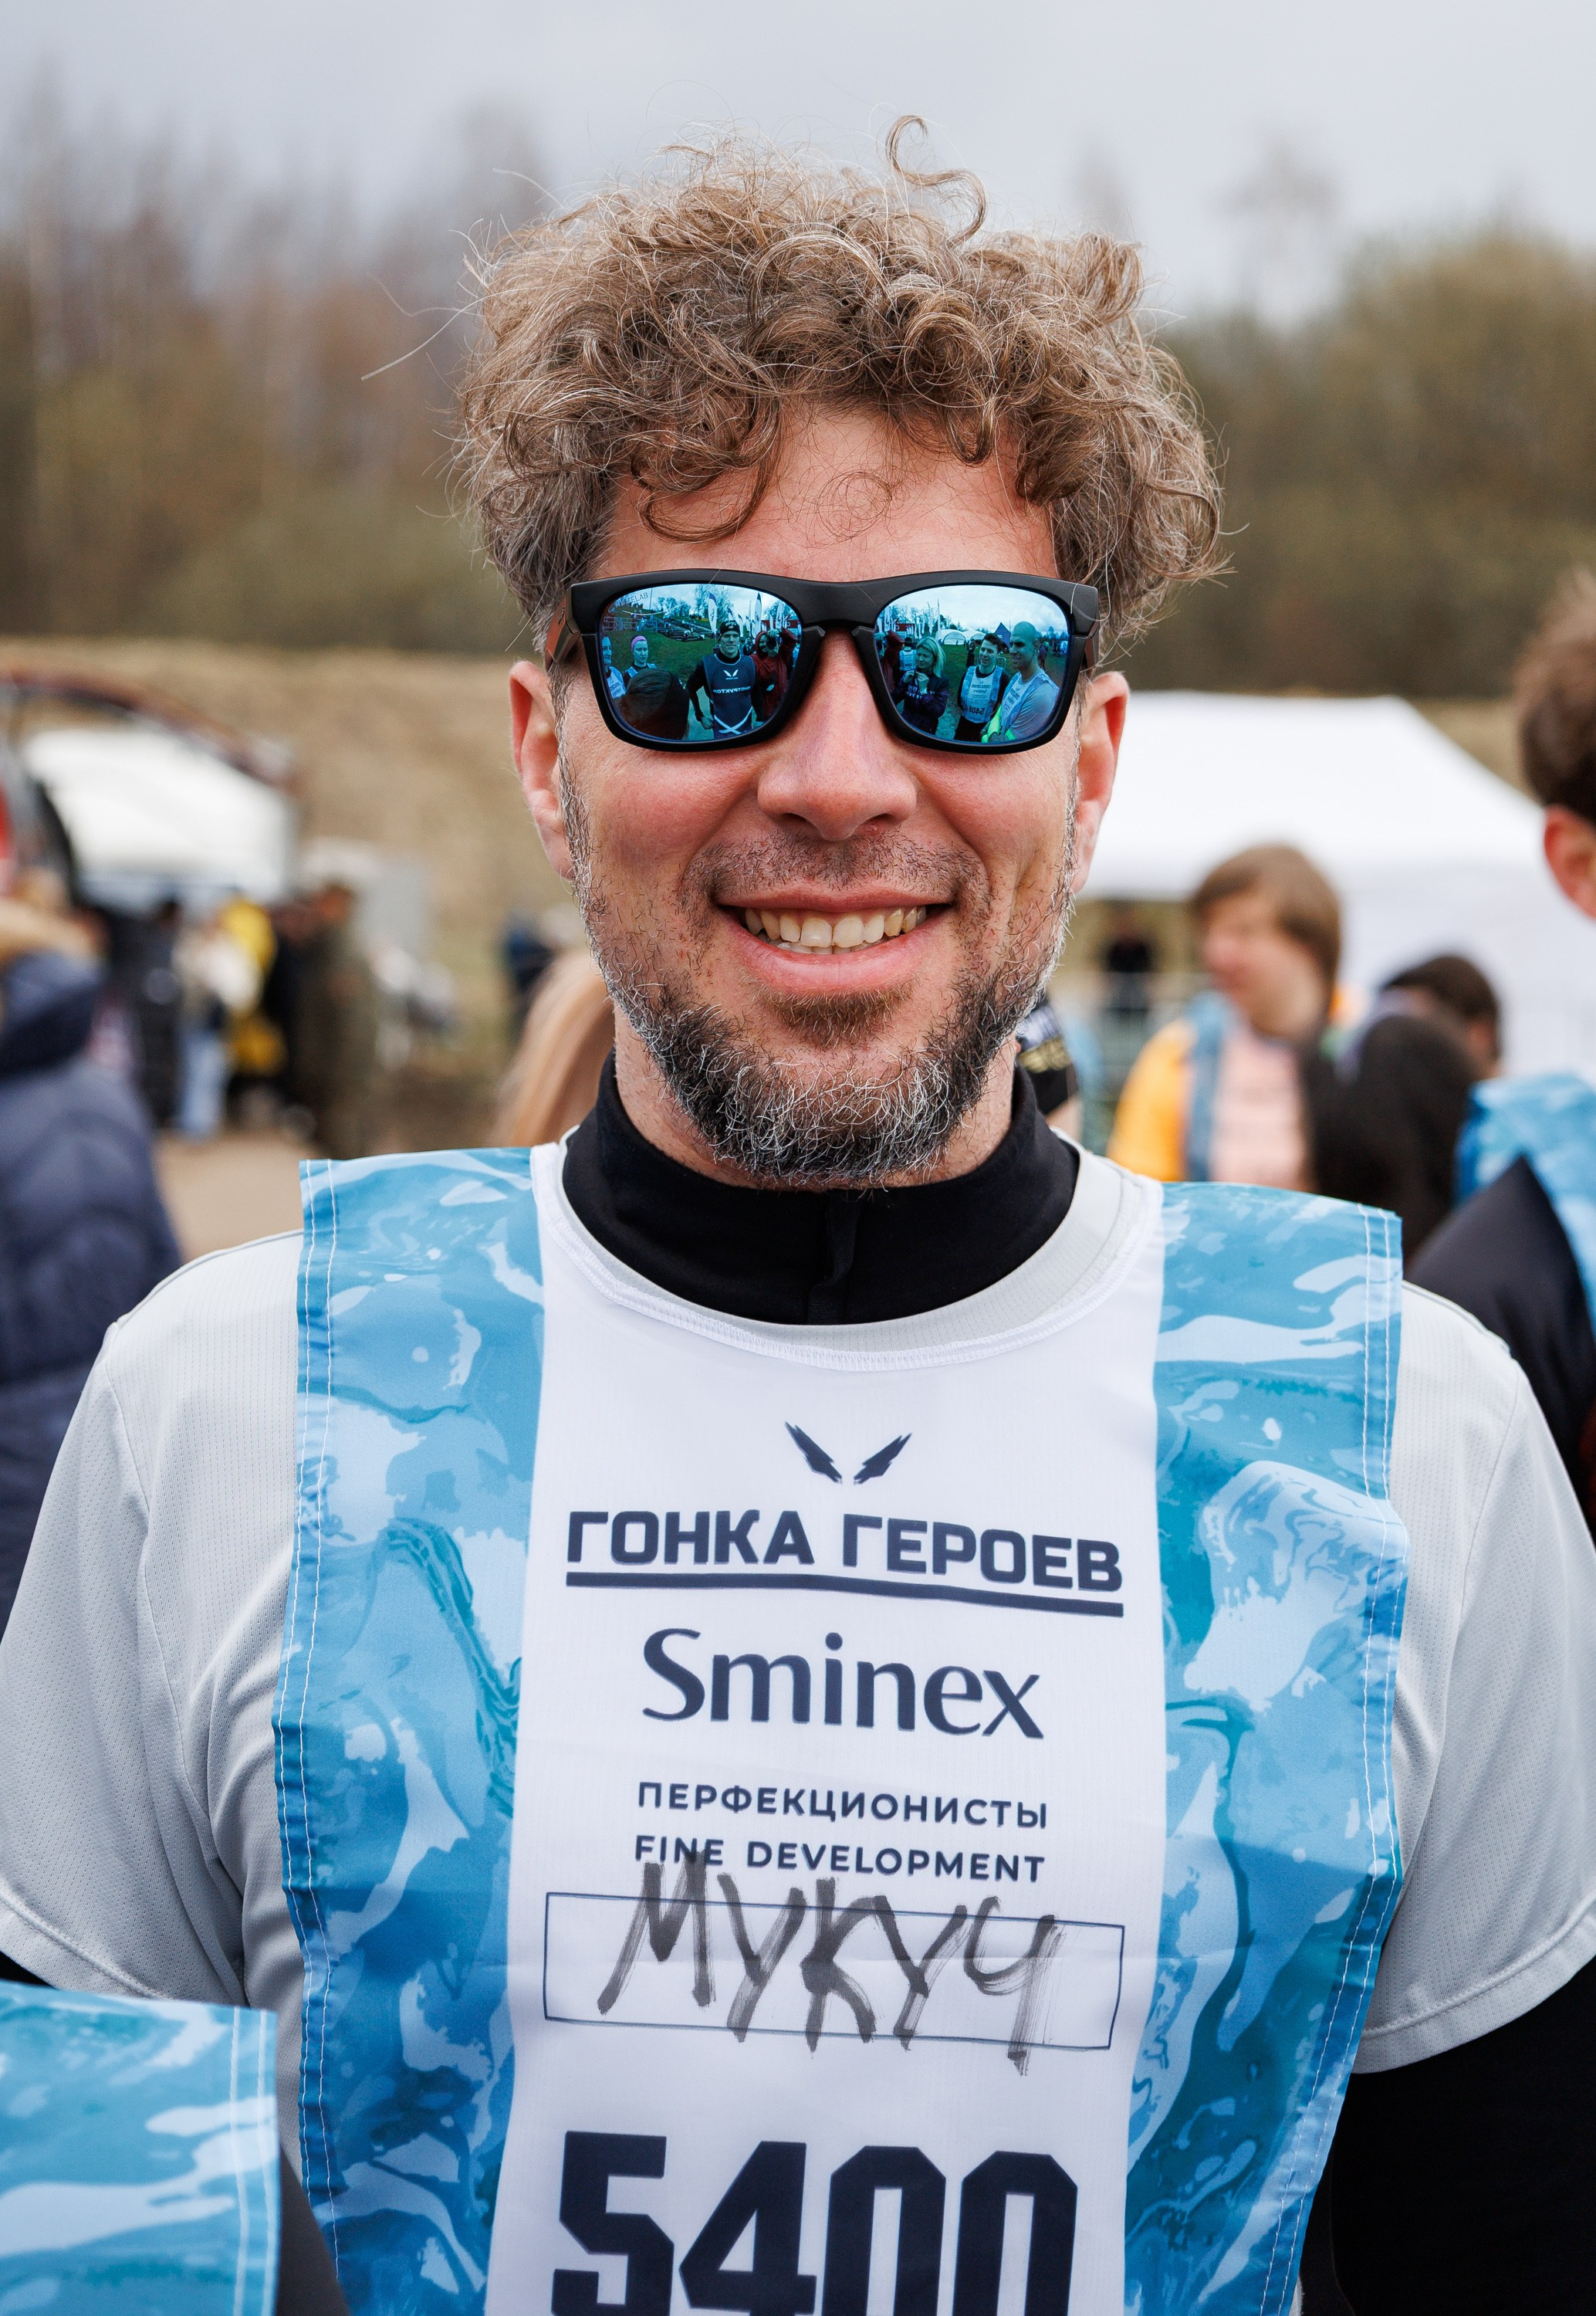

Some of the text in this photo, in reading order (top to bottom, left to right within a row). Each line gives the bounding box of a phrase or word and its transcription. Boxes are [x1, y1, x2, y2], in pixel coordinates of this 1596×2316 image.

[566, 1509, 1123, 1593] ГОНКА ГЕРОЕВ
[642, 1628, 1044, 1739] Sminex
[637, 1782, 1047, 1829] ПЕРФЕКЦИОНИСТЫ
[634, 1834, 1045, 1883] FINE DEVELOPMENT
[551, 2130, 1078, 2316] 5400
